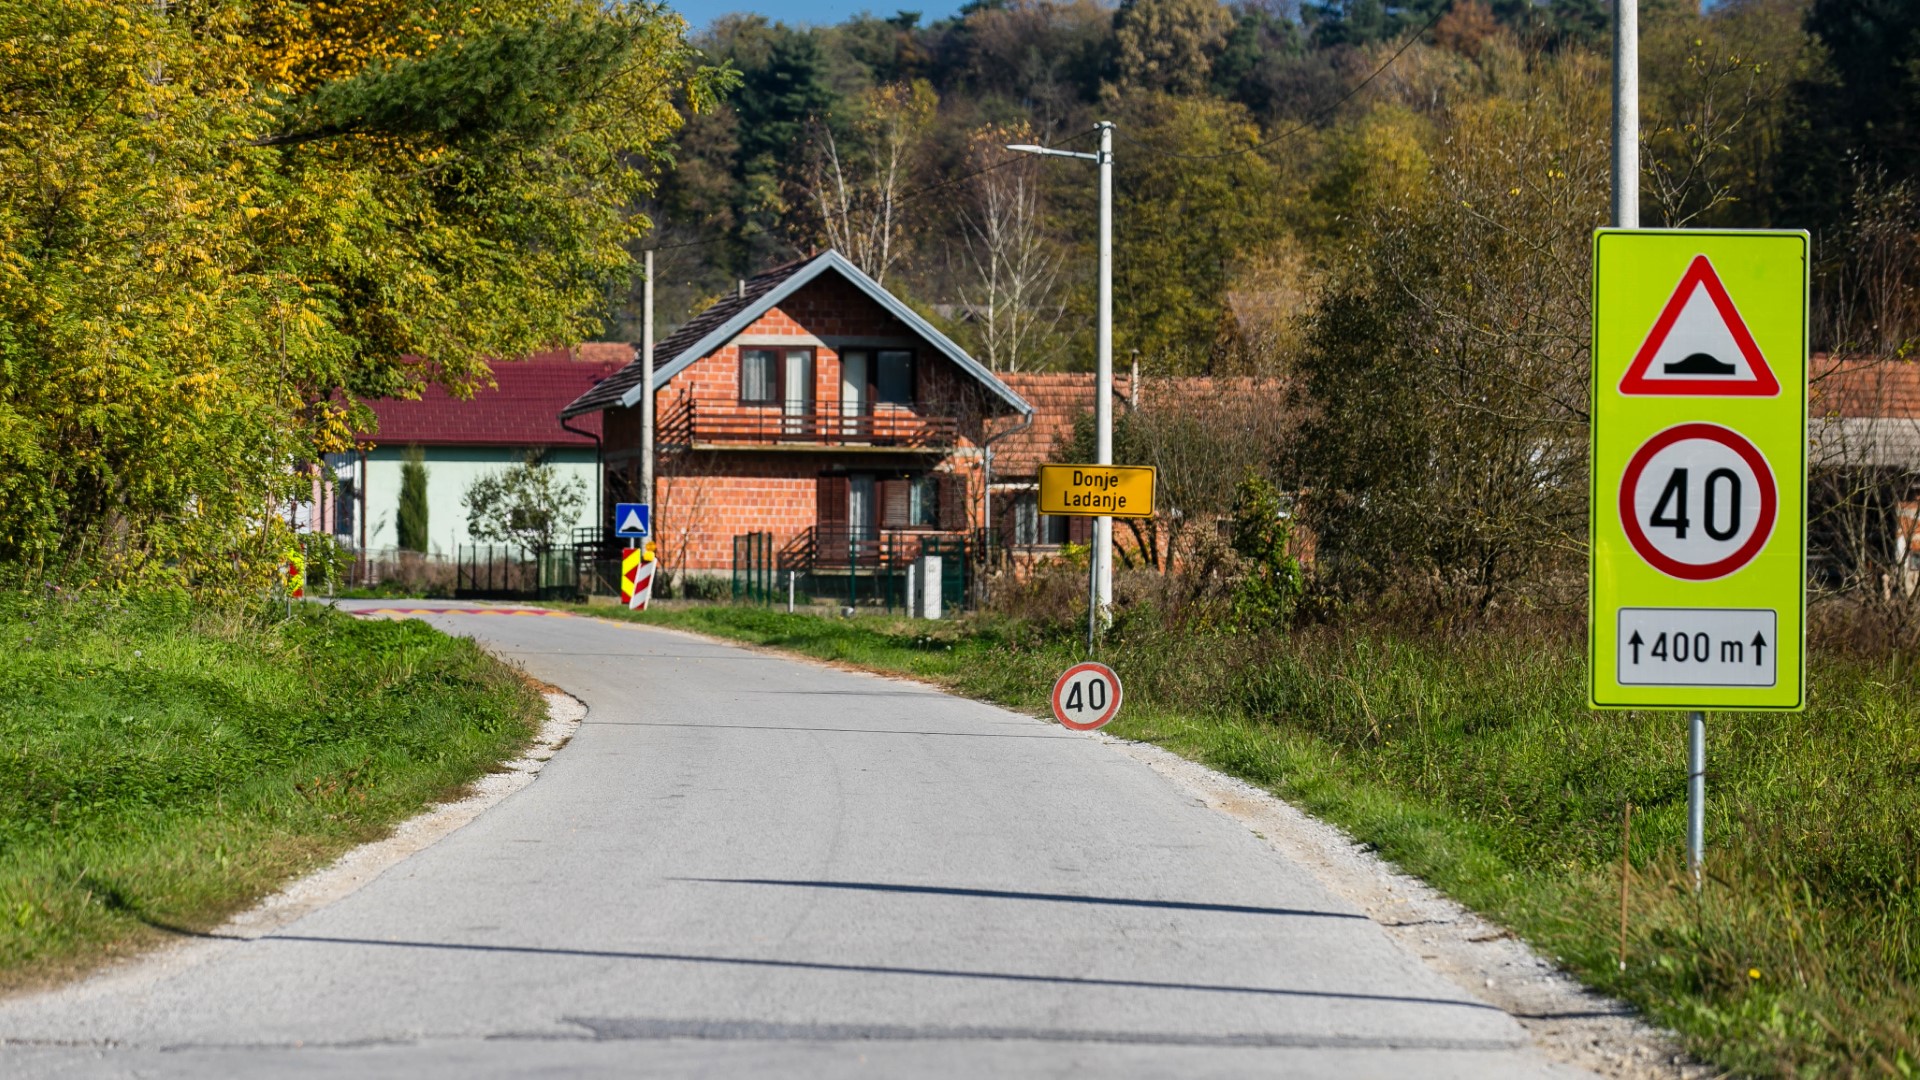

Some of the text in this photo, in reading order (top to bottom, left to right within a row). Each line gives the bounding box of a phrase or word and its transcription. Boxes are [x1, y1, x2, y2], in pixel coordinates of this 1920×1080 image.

[1073, 470, 1118, 491] Donje
[1064, 490, 1126, 511] Ladanje
[1649, 467, 1741, 541] 40
[1651, 632, 1743, 662] 400 m
[1066, 678, 1106, 712] 40
